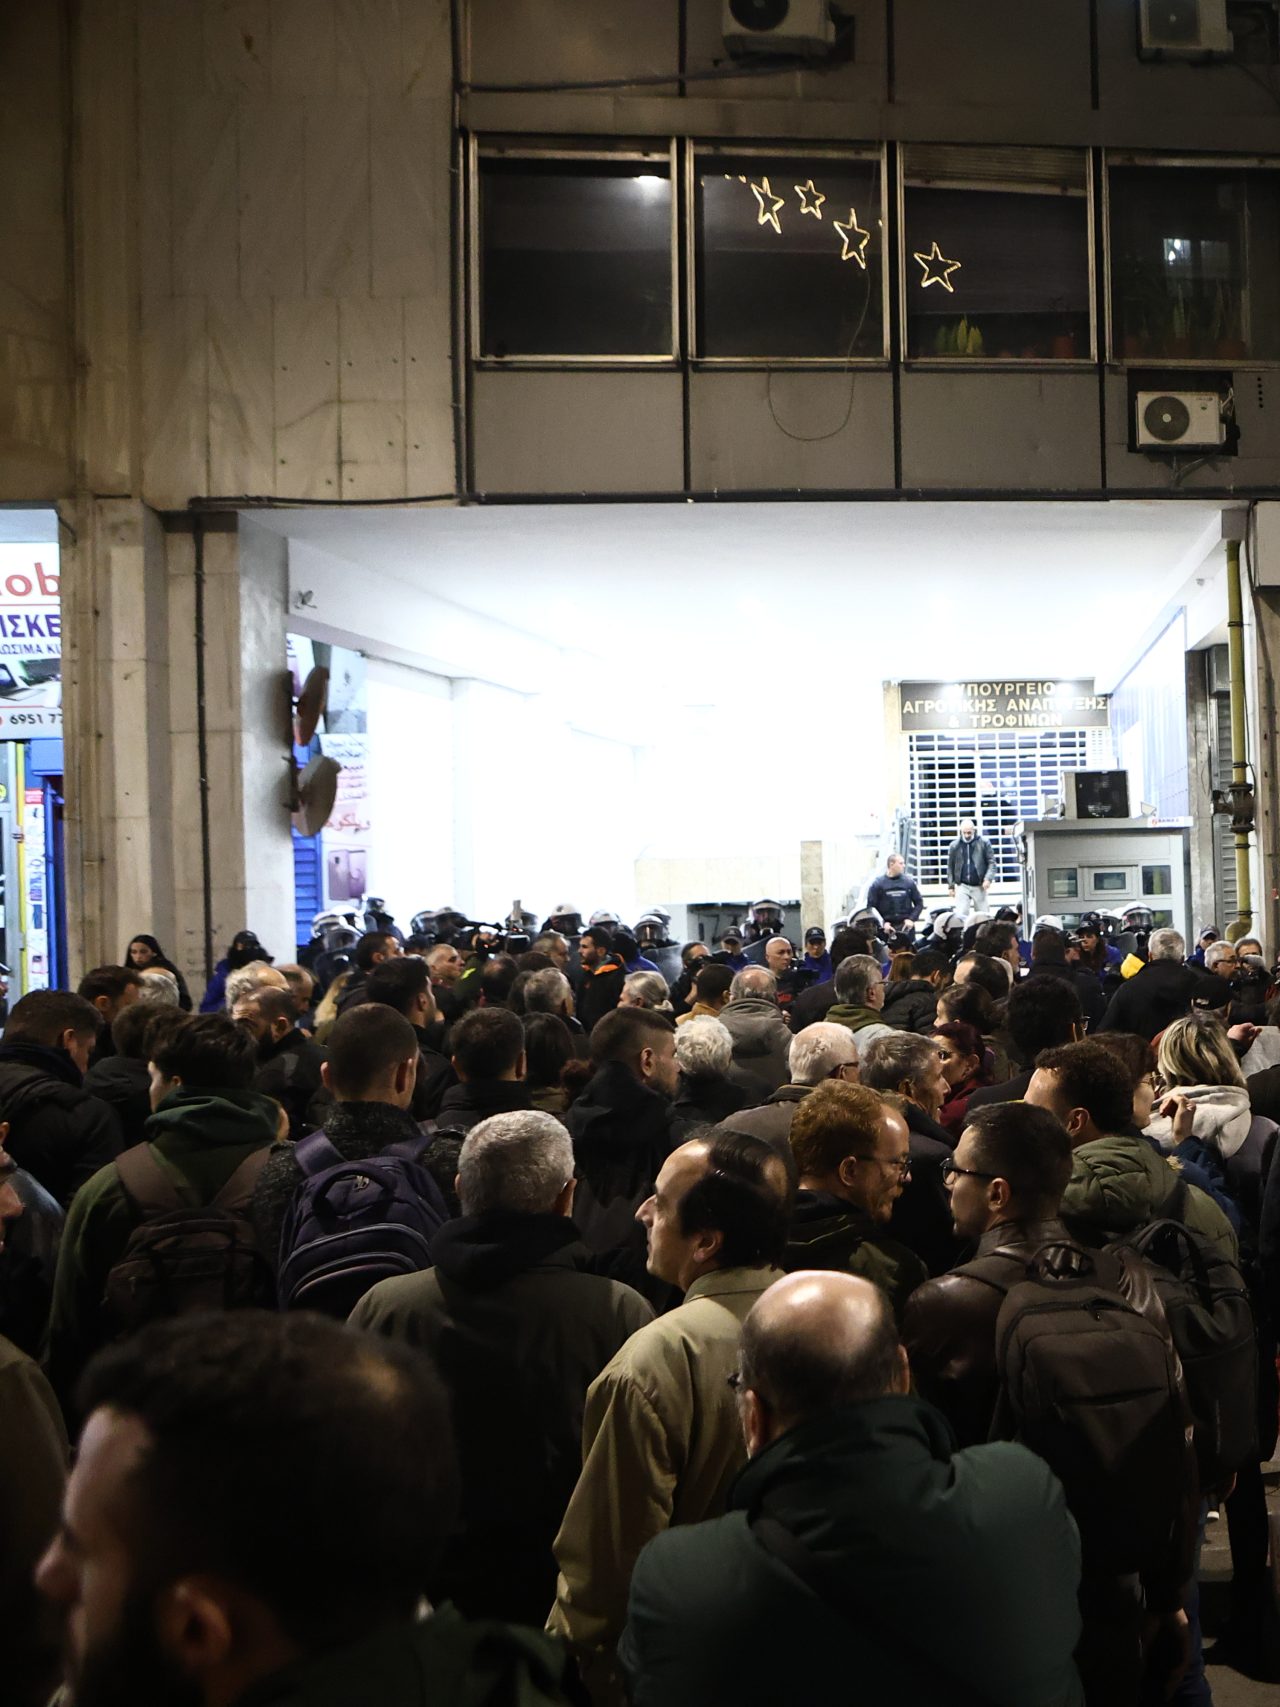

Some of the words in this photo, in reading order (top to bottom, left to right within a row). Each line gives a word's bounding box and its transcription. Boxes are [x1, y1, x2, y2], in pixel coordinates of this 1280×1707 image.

[0, 562, 62, 597] ob
[903, 699, 997, 714] ΑΓΡΟΙΚΗΣ
[1007, 697, 1107, 712] ΑΝΑΠΞΗΣ
[9, 713, 44, 725] 6951
[969, 713, 1063, 728] ΤΡΟΦΙΜΩΝ
